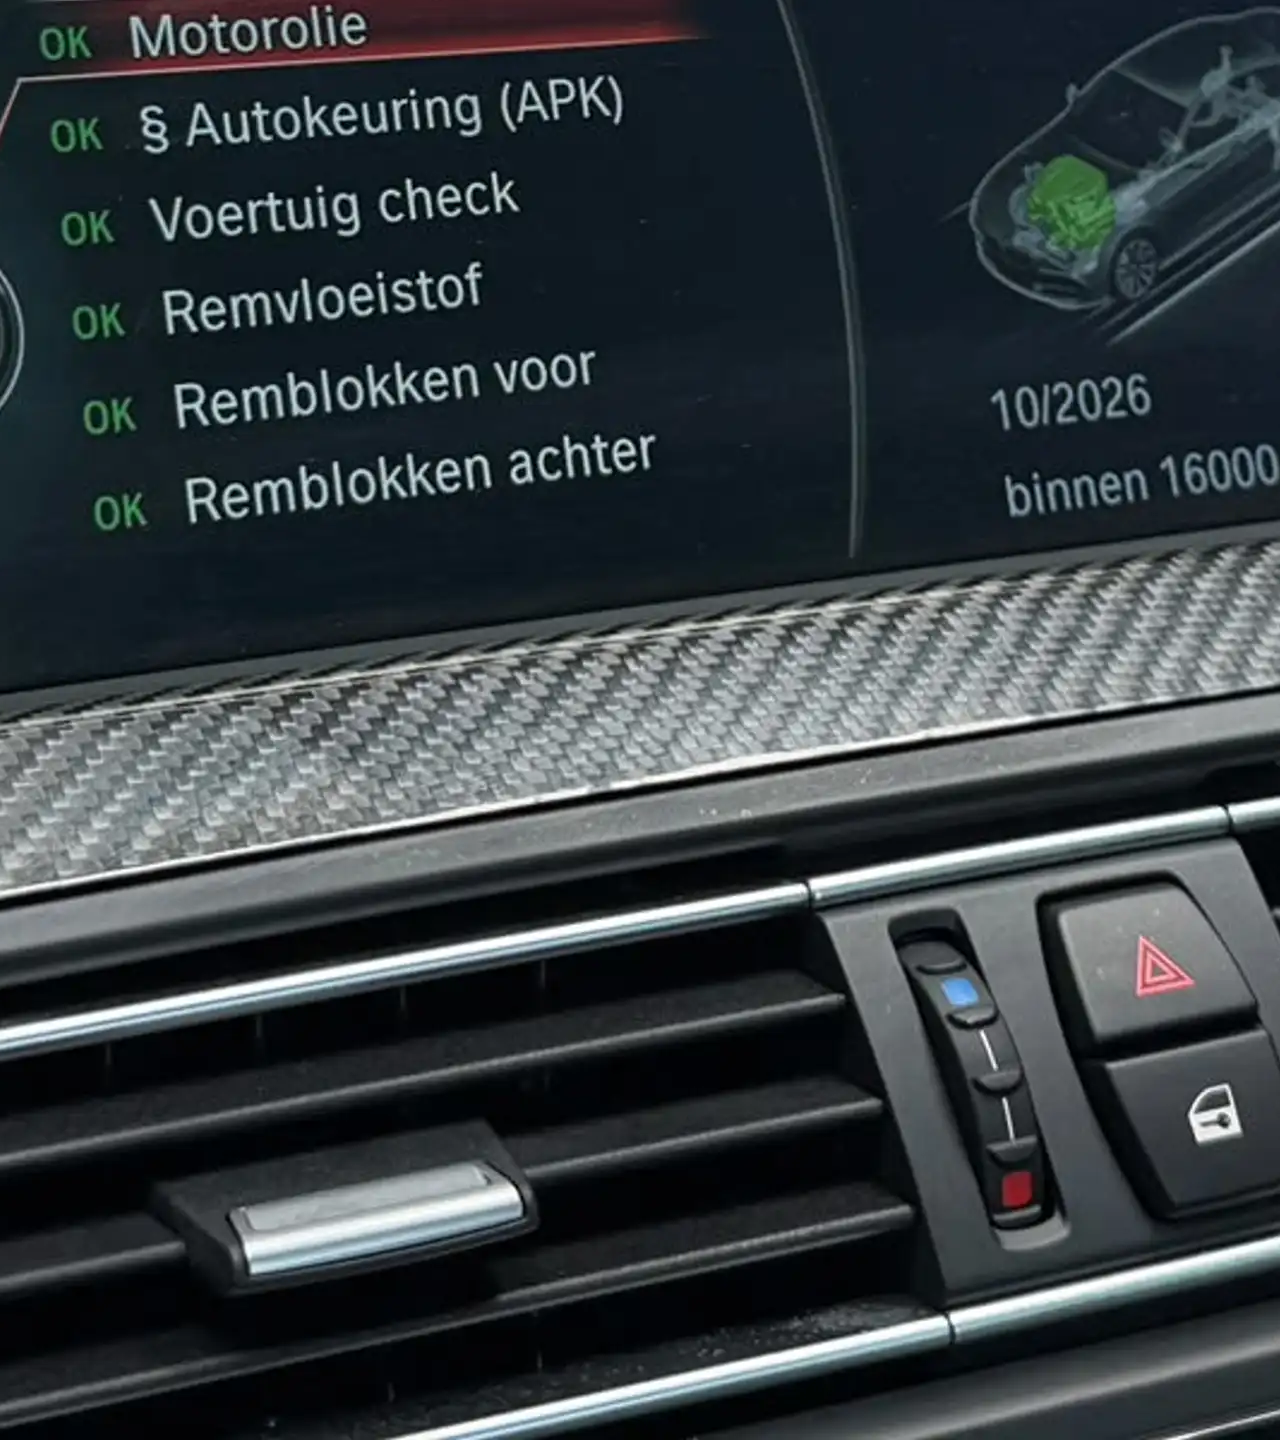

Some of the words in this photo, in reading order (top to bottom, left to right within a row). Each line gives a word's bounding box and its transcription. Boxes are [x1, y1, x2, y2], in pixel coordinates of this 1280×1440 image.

[39, 25, 92, 61] OK
[129, 4, 368, 60] Motorolie
[50, 117, 103, 153] OK
[140, 105, 170, 154] §
[185, 88, 482, 147] Autokeuring
[500, 75, 623, 131] (APK)
[61, 209, 115, 246] OK
[148, 185, 361, 241] Voertuig
[379, 171, 520, 223] check
[72, 302, 126, 340] OK
[162, 261, 483, 335] Remvloeistof
[83, 397, 137, 435] OK
[174, 364, 480, 429] Remblokken
[493, 351, 596, 394] voor
[990, 373, 1151, 431] 10/2026
[94, 492, 148, 531] OK
[185, 453, 492, 524] Remblokken
[509, 434, 656, 485] achter
[1004, 468, 1149, 517] binnen
[1159, 444, 1280, 497] 16000
